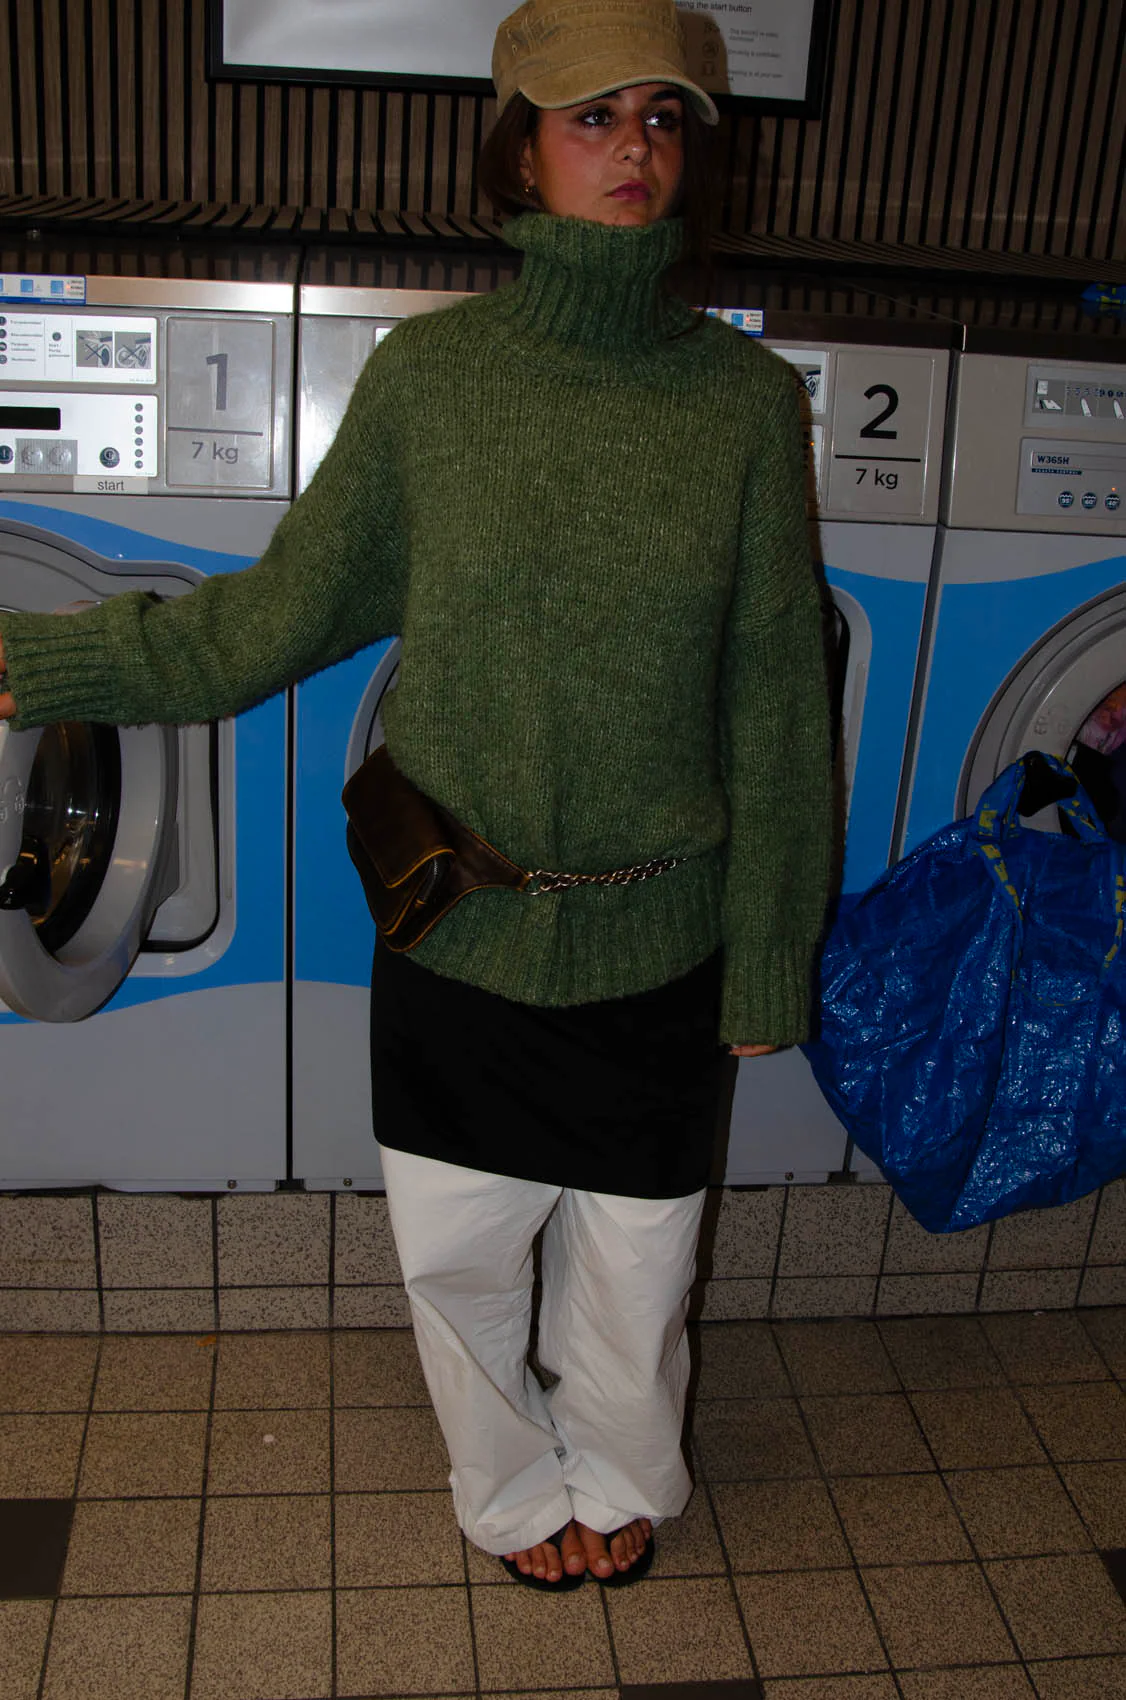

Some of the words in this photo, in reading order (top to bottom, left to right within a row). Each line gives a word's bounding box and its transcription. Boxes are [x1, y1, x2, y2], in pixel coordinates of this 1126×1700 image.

[696, 1, 709, 10] the
[710, 2, 727, 11] start
[728, 4, 752, 13] button
[206, 353, 228, 410] 1
[860, 384, 898, 439] 2
[192, 441, 204, 459] 7
[212, 441, 239, 464] kg
[1037, 455, 1070, 465] W365H
[97, 480, 125, 491] start
[856, 468, 867, 485] 7
[874, 468, 898, 490] kg
